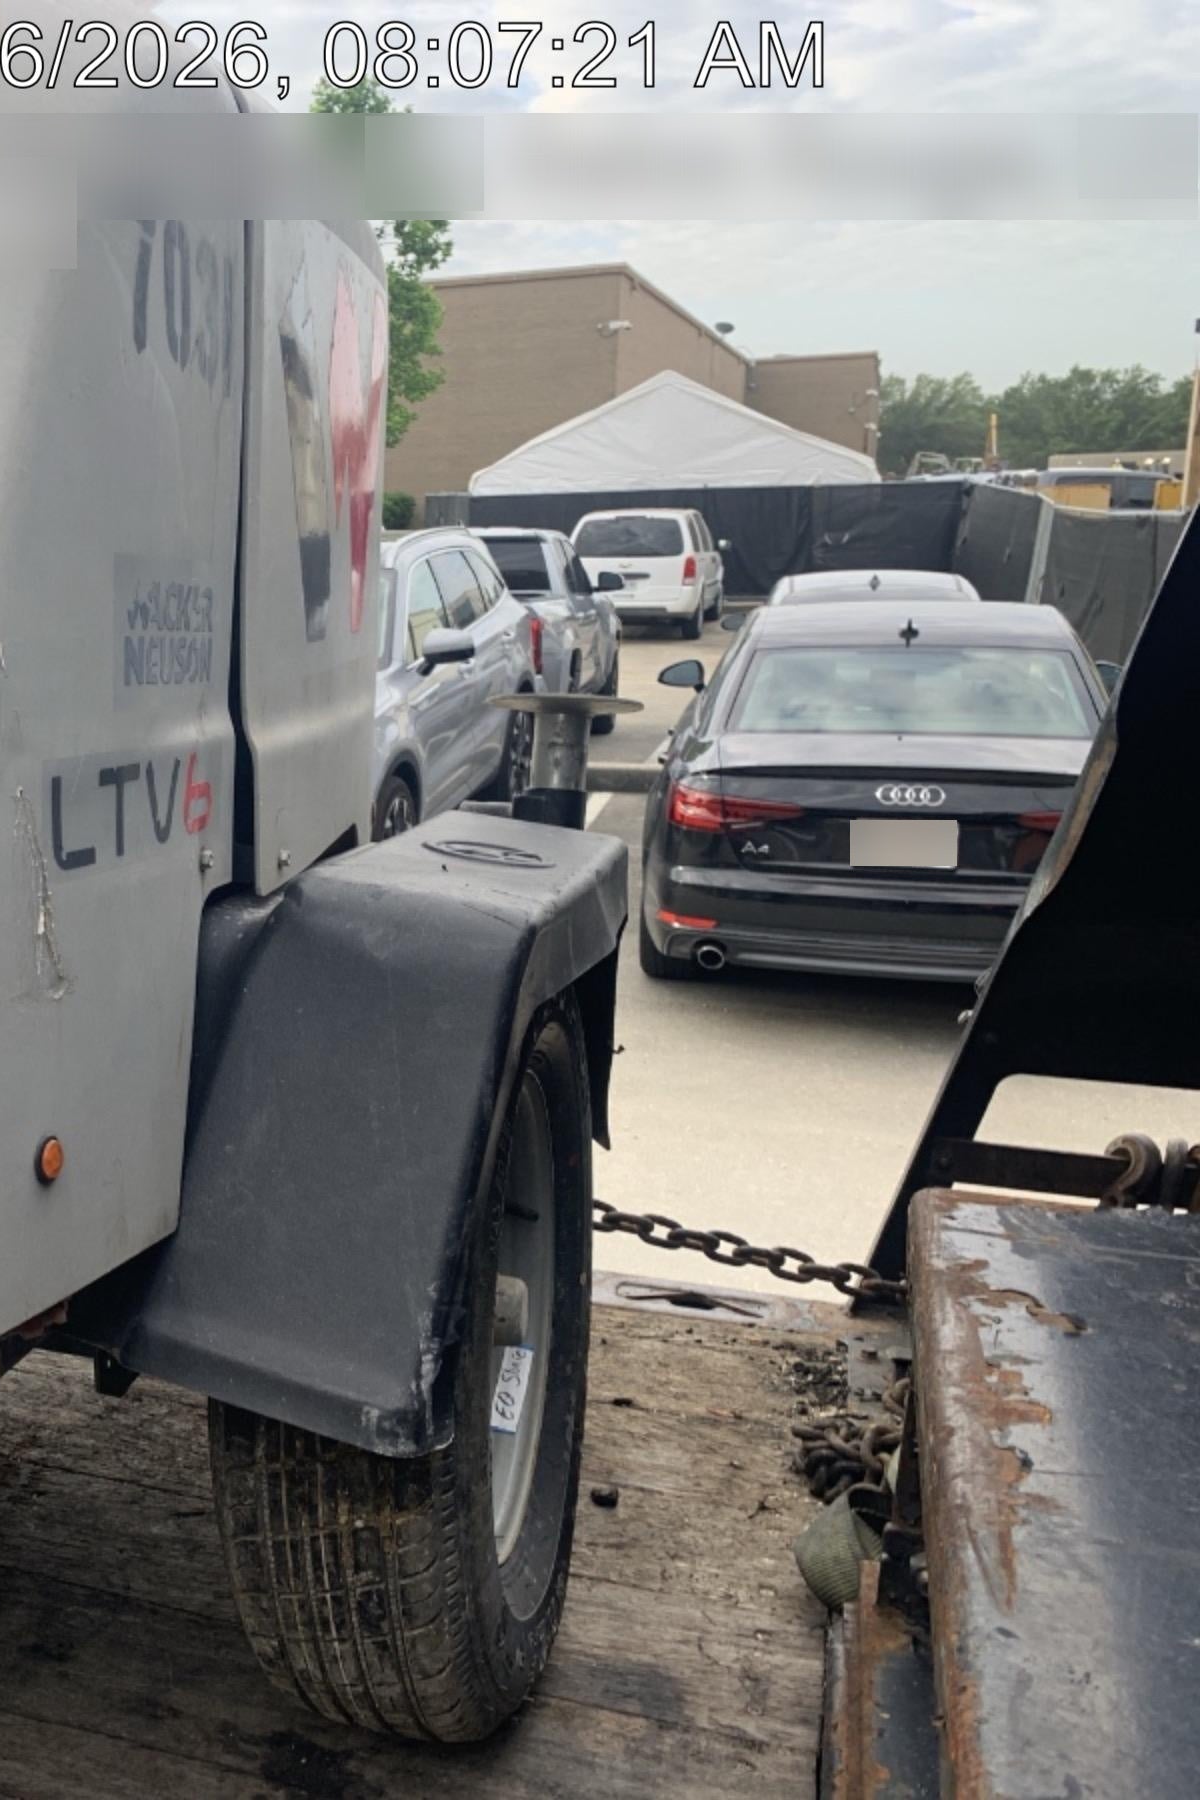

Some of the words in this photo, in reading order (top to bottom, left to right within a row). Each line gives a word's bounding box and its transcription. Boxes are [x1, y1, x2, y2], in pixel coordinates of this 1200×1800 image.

[123, 636, 213, 687] NEUSON
[51, 752, 213, 870] LTV6
[740, 839, 769, 856] A4
